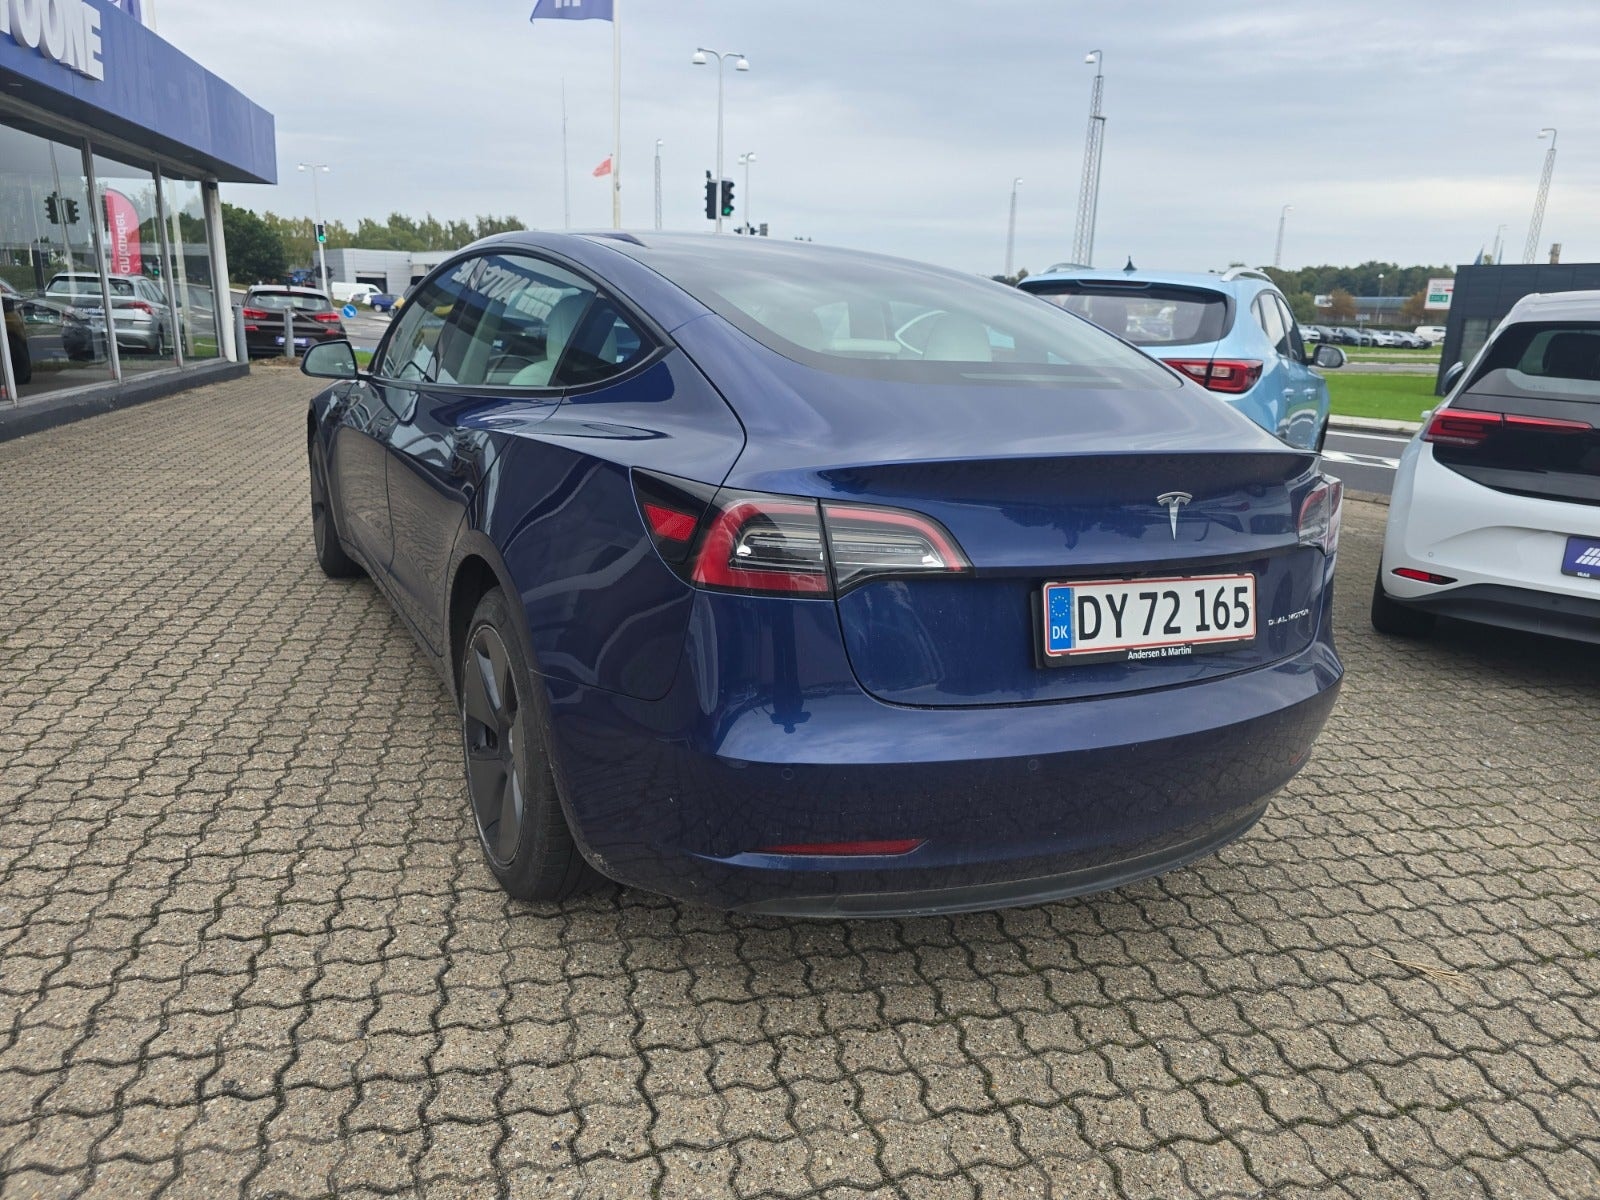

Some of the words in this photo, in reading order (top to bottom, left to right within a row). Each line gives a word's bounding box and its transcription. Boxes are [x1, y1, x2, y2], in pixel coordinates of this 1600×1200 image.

[1077, 593, 1129, 641] DY
[1138, 590, 1182, 636] 72
[1194, 586, 1250, 633] 165
[1268, 615, 1288, 626] DAL
[1052, 625, 1068, 640] DK
[1127, 649, 1160, 660] Andersen
[1160, 648, 1167, 657] &
[1167, 645, 1192, 656] Martini
